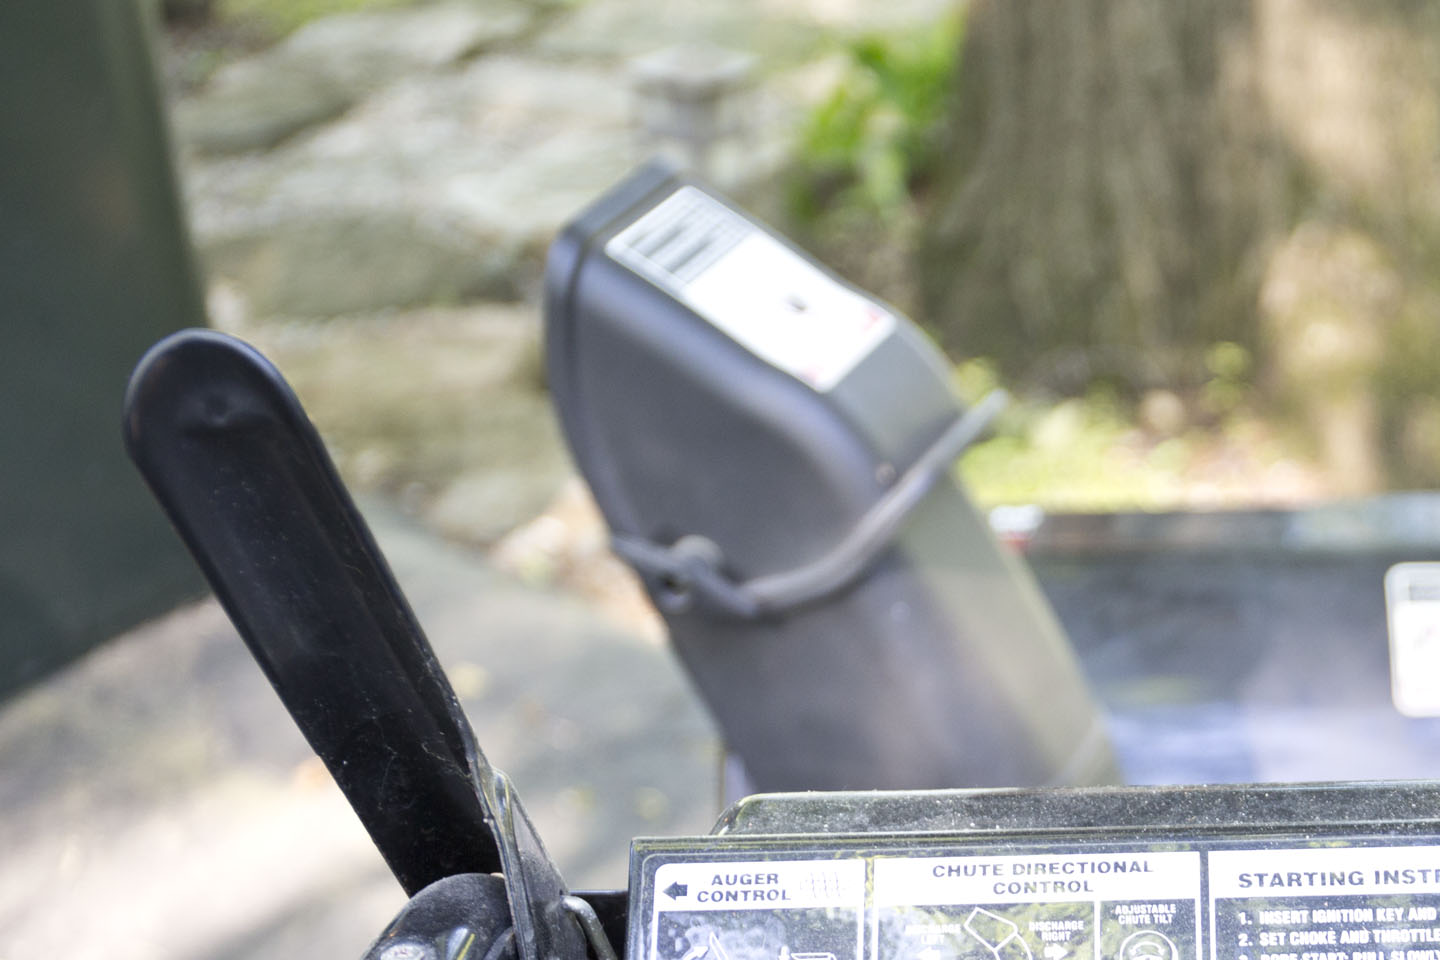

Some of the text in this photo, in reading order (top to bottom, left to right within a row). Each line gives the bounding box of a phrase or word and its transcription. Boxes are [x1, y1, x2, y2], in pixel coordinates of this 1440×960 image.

[932, 861, 1154, 877] CHUTE DIRECTIONAL
[711, 873, 779, 886] AUGER
[1238, 870, 1365, 888] STARTING
[993, 880, 1094, 895] CONTROL
[697, 889, 791, 902] CONTROL
[1115, 904, 1176, 915] ADJUSTABLE
[1238, 911, 1252, 925] 1.
[1259, 910, 1308, 925] INSERT
[1312, 908, 1373, 923] IGNITION
[1376, 908, 1404, 922] KEY
[1408, 906, 1436, 921] AND
[1029, 920, 1084, 931] DISCHARGE
[1118, 913, 1173, 925] CHUTE TILT
[1041, 930, 1071, 941] RIGHT
[1238, 933, 1253, 946] 2.
[1259, 932, 1286, 946] SET
[1290, 930, 1336, 946] CHOKE
[1340, 929, 1370, 944] AND
